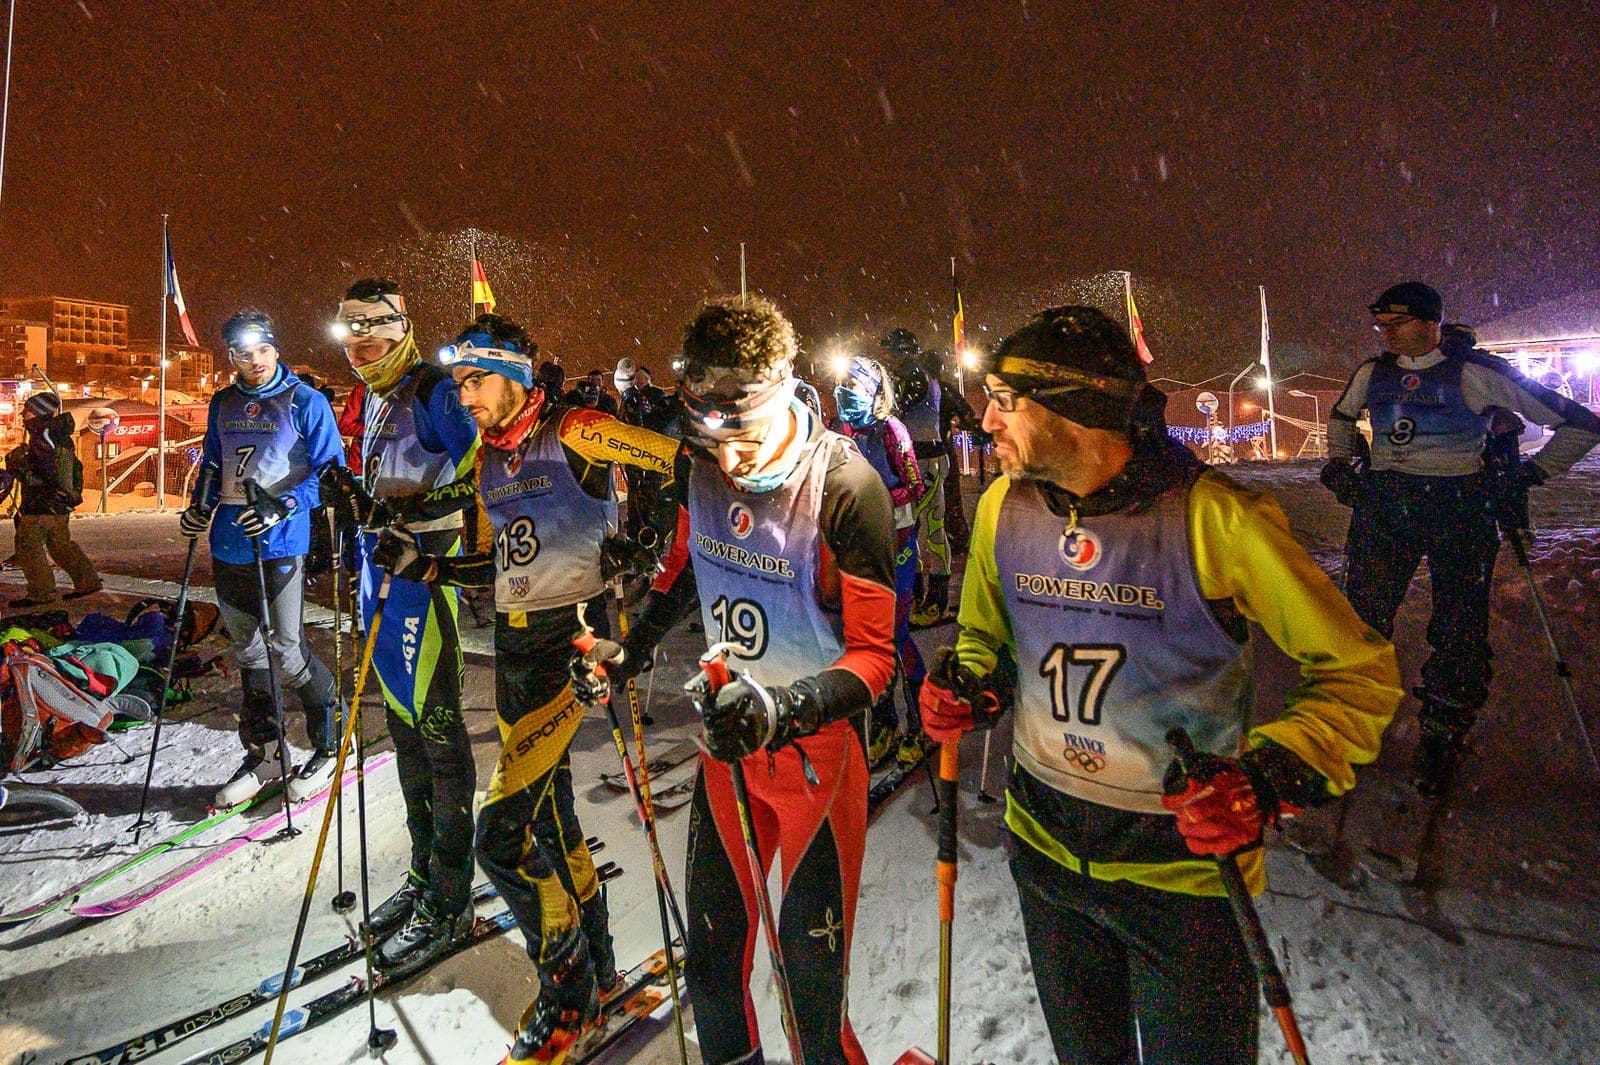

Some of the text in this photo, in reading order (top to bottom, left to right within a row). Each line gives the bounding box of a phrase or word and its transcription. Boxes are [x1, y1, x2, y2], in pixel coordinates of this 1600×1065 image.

[580, 428, 603, 444] LA
[1388, 417, 1416, 445] 8
[236, 445, 256, 477] 7
[498, 515, 541, 571] 13
[711, 594, 769, 661] 19
[1039, 642, 1127, 726] 17
[1064, 733, 1106, 753] FRANCE
